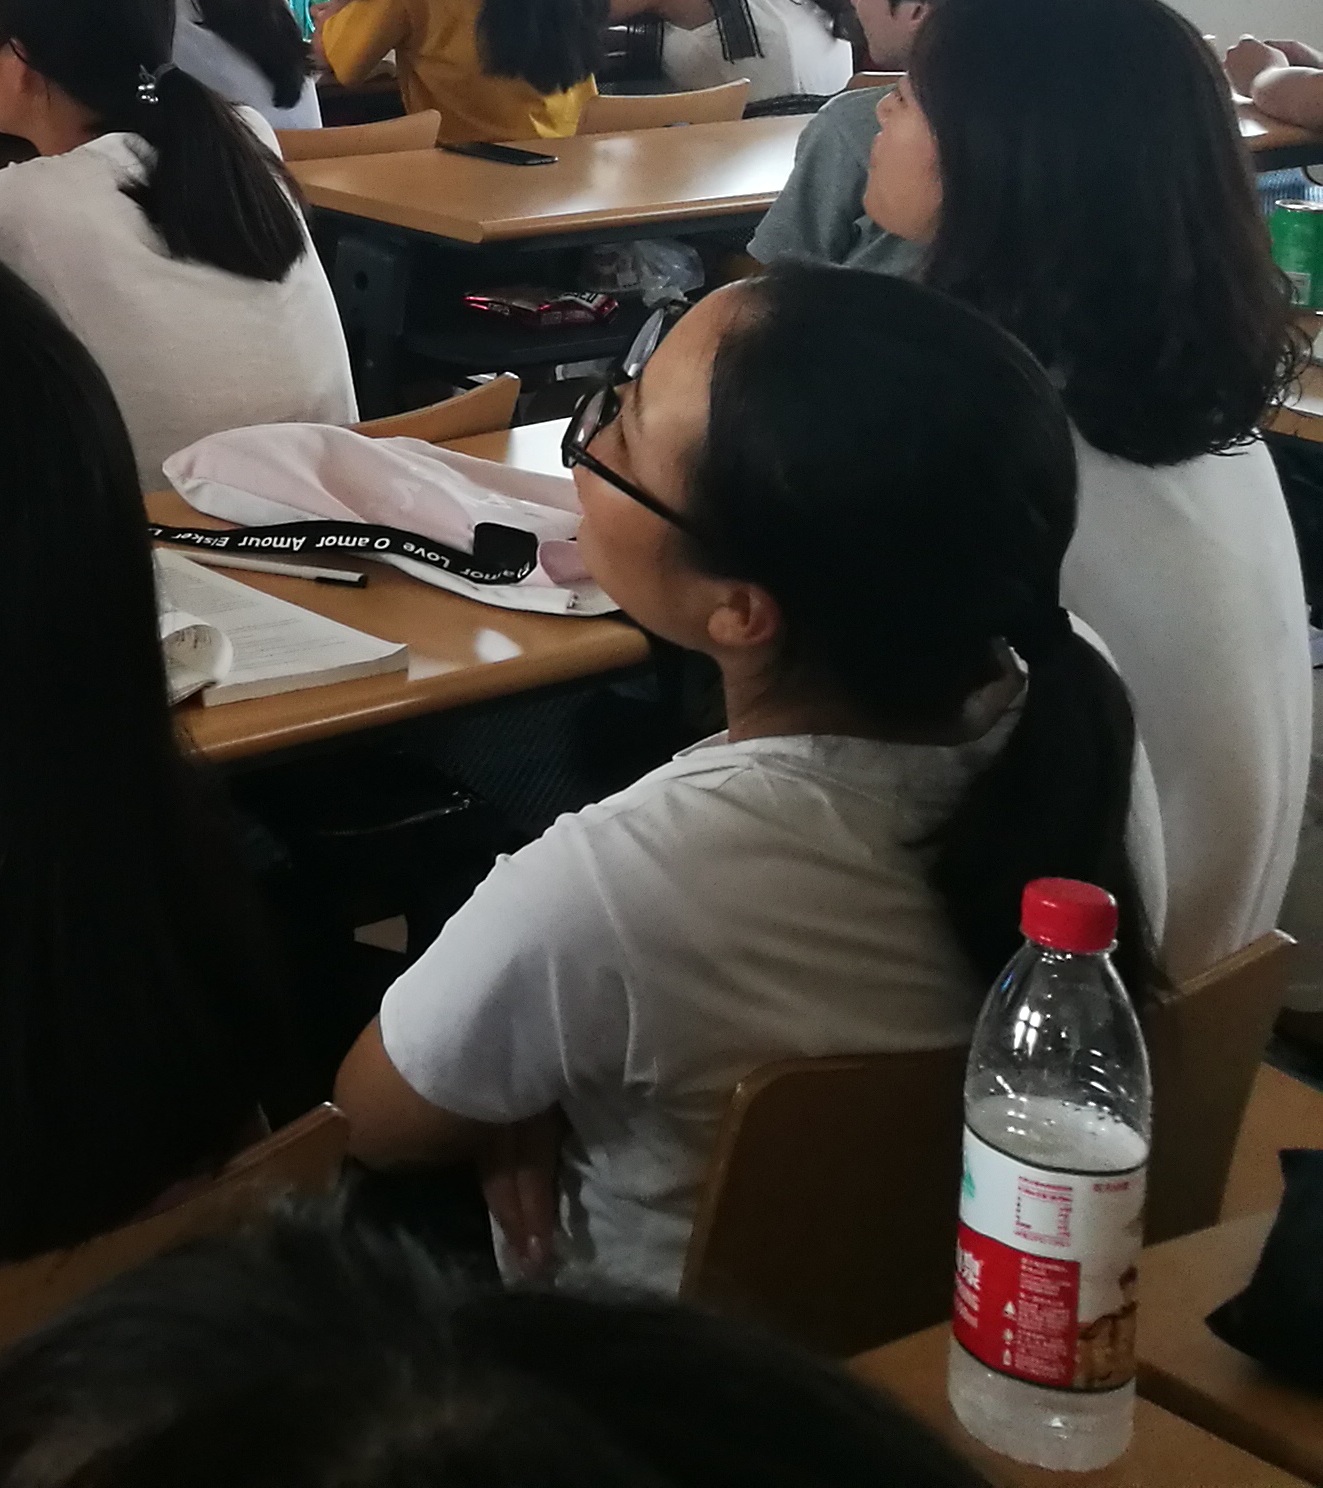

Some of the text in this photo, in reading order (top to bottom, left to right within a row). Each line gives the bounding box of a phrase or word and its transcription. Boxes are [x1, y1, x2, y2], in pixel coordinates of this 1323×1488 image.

[237, 535, 307, 552] Amour
[315, 535, 370, 548] amor
[374, 537, 391, 550] O
[403, 542, 451, 569] Love
